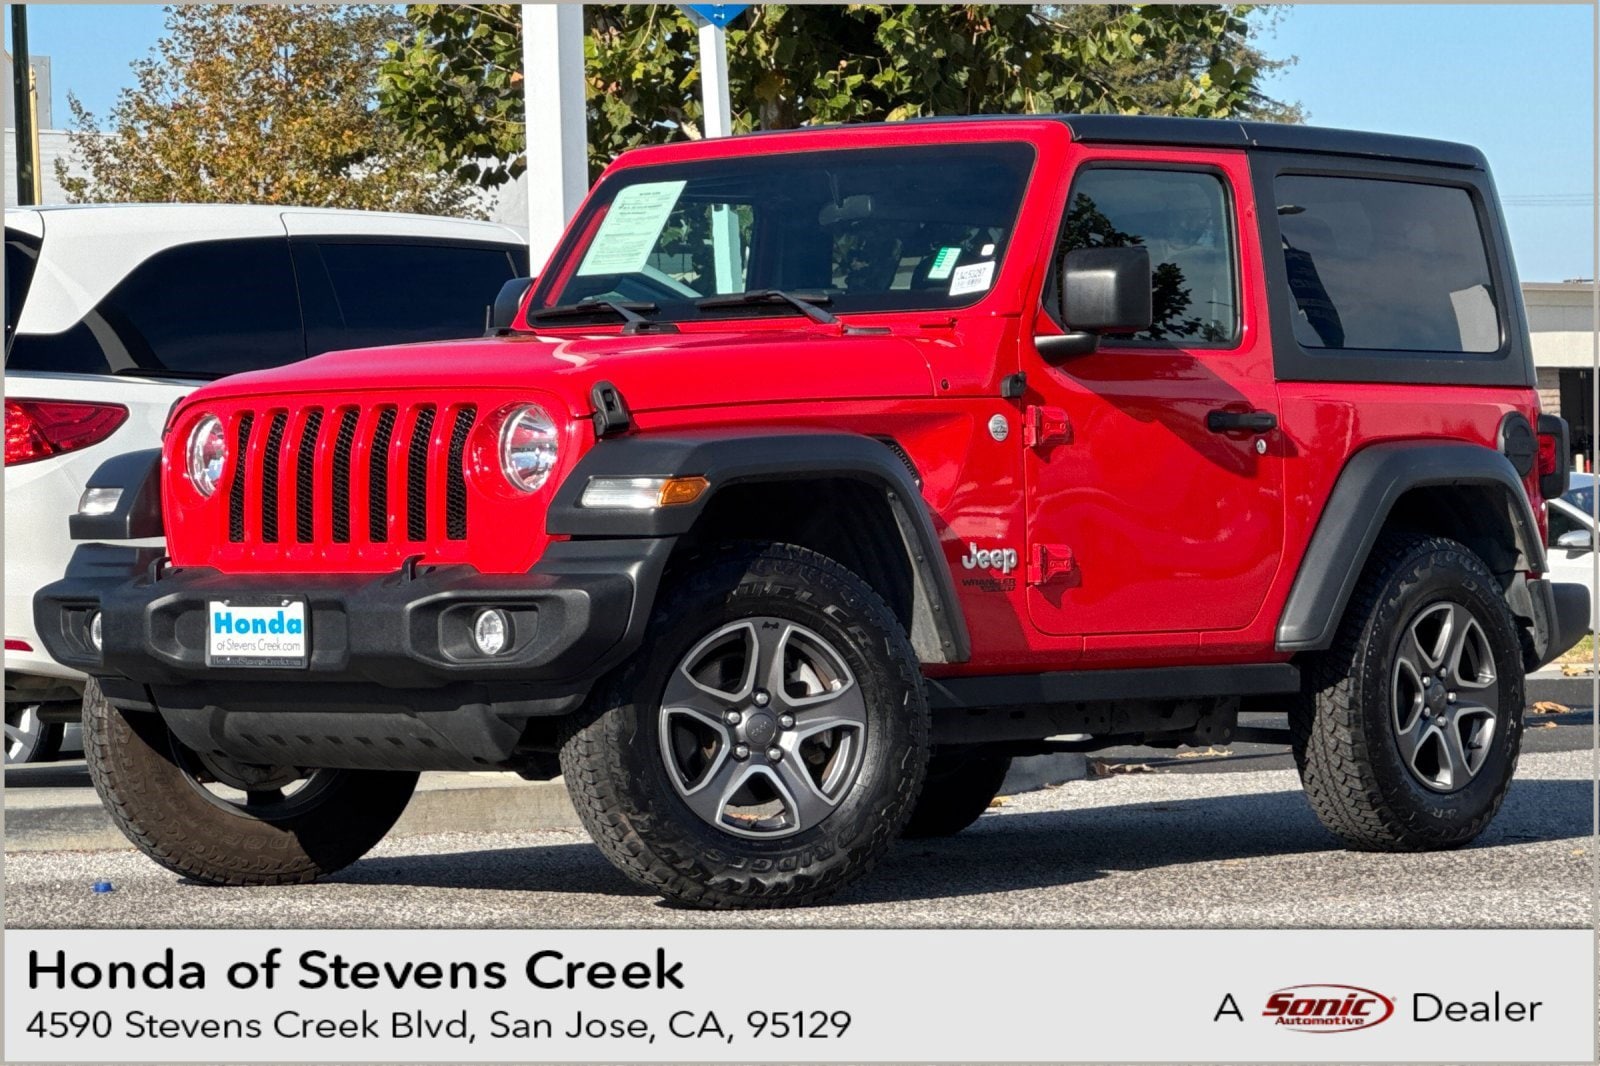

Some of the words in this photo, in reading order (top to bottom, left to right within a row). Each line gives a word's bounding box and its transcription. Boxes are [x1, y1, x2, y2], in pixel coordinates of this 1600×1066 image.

[962, 541, 1018, 574] Jeep
[214, 610, 302, 634] Honda
[216, 639, 226, 651] of
[226, 638, 257, 651] Stevens
[257, 637, 301, 651] Creek.com
